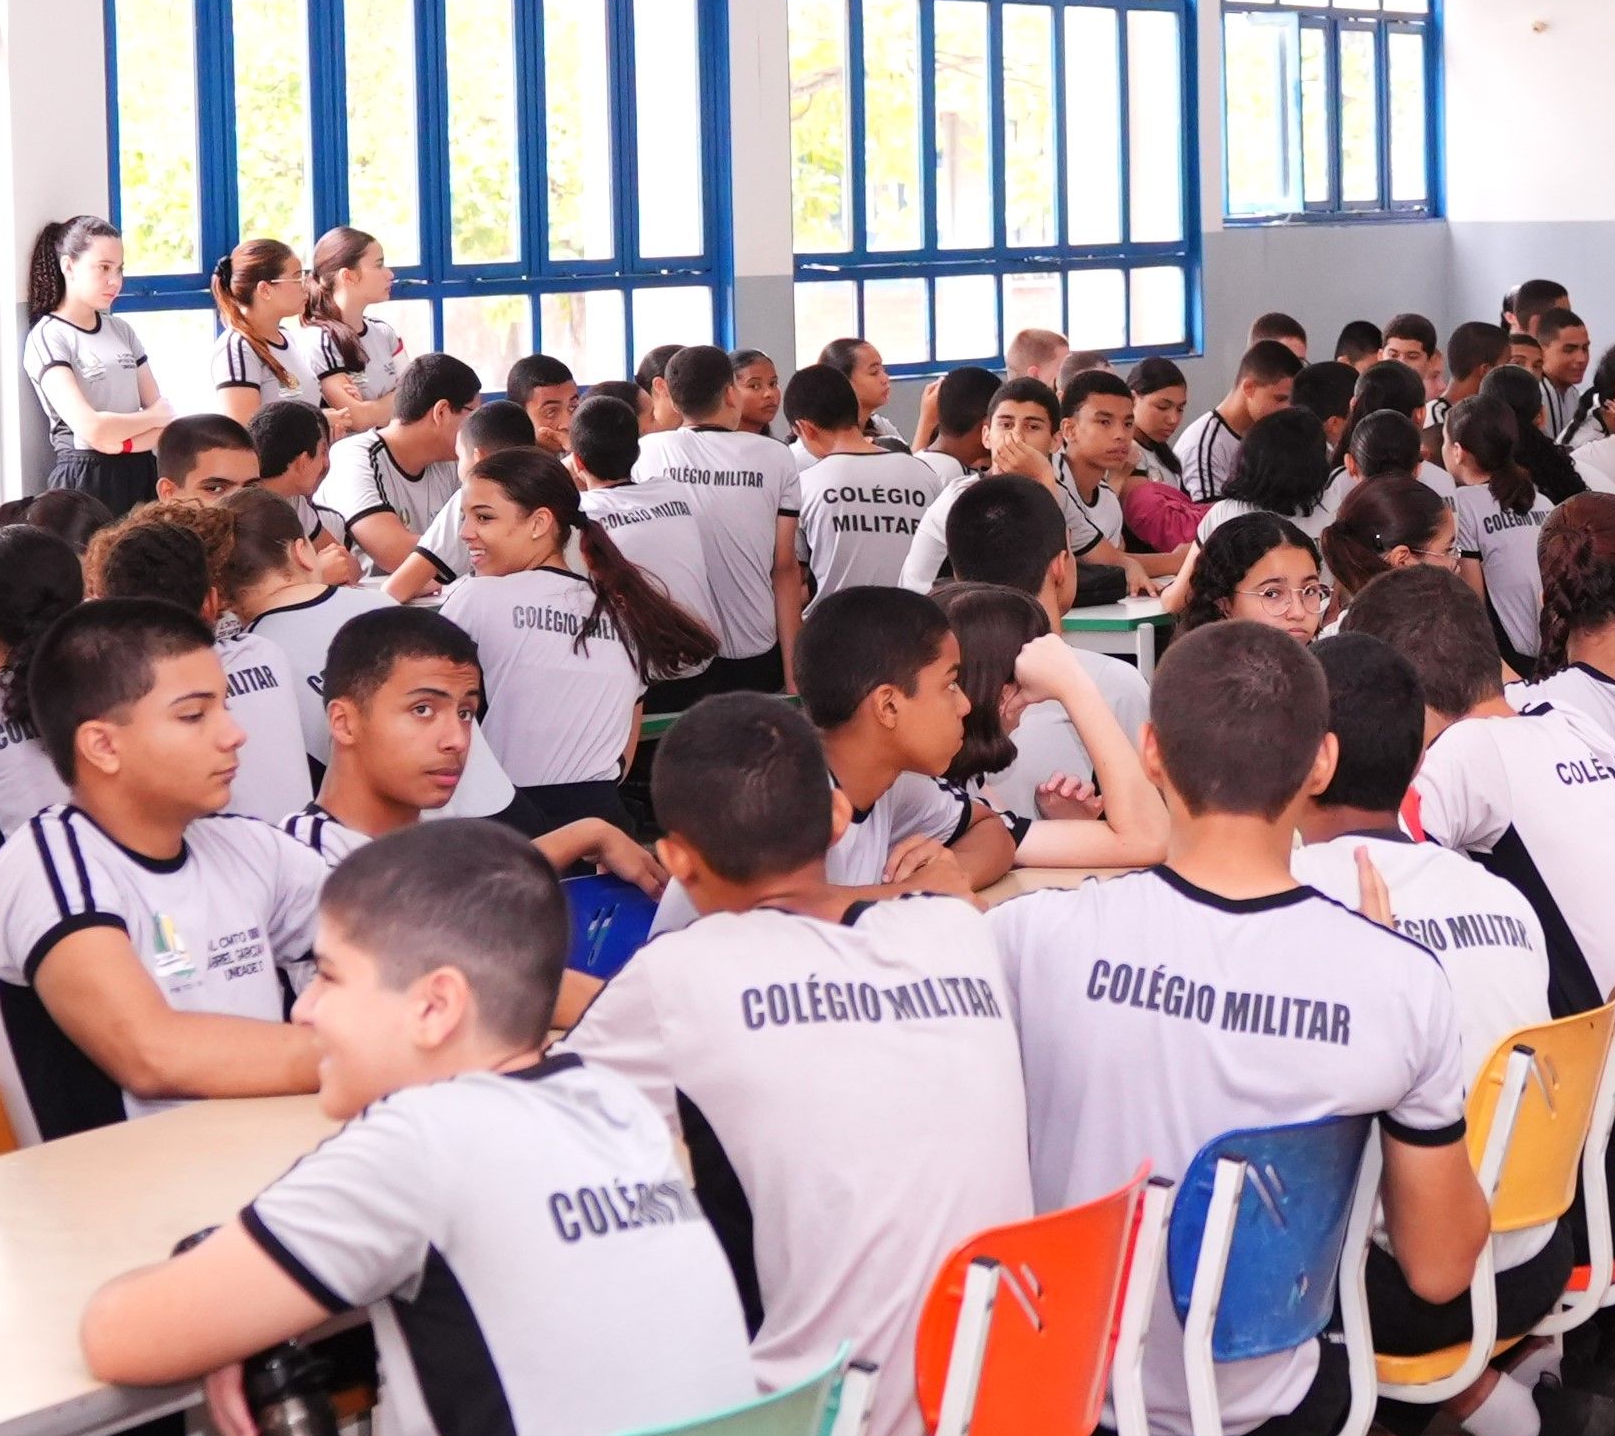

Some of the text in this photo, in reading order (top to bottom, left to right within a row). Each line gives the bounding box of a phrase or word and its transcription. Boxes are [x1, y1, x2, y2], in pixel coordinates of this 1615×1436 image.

[713, 470, 764, 488] MILITAR
[823, 484, 926, 508] COLÉGIO
[513, 605, 578, 636] COLÉGIO
[1446, 914, 1533, 952] MILITAR
[742, 973, 1003, 1031] COLÉGIO MILITAR
[1086, 959, 1352, 1047] COLÉGIO MILITAR
